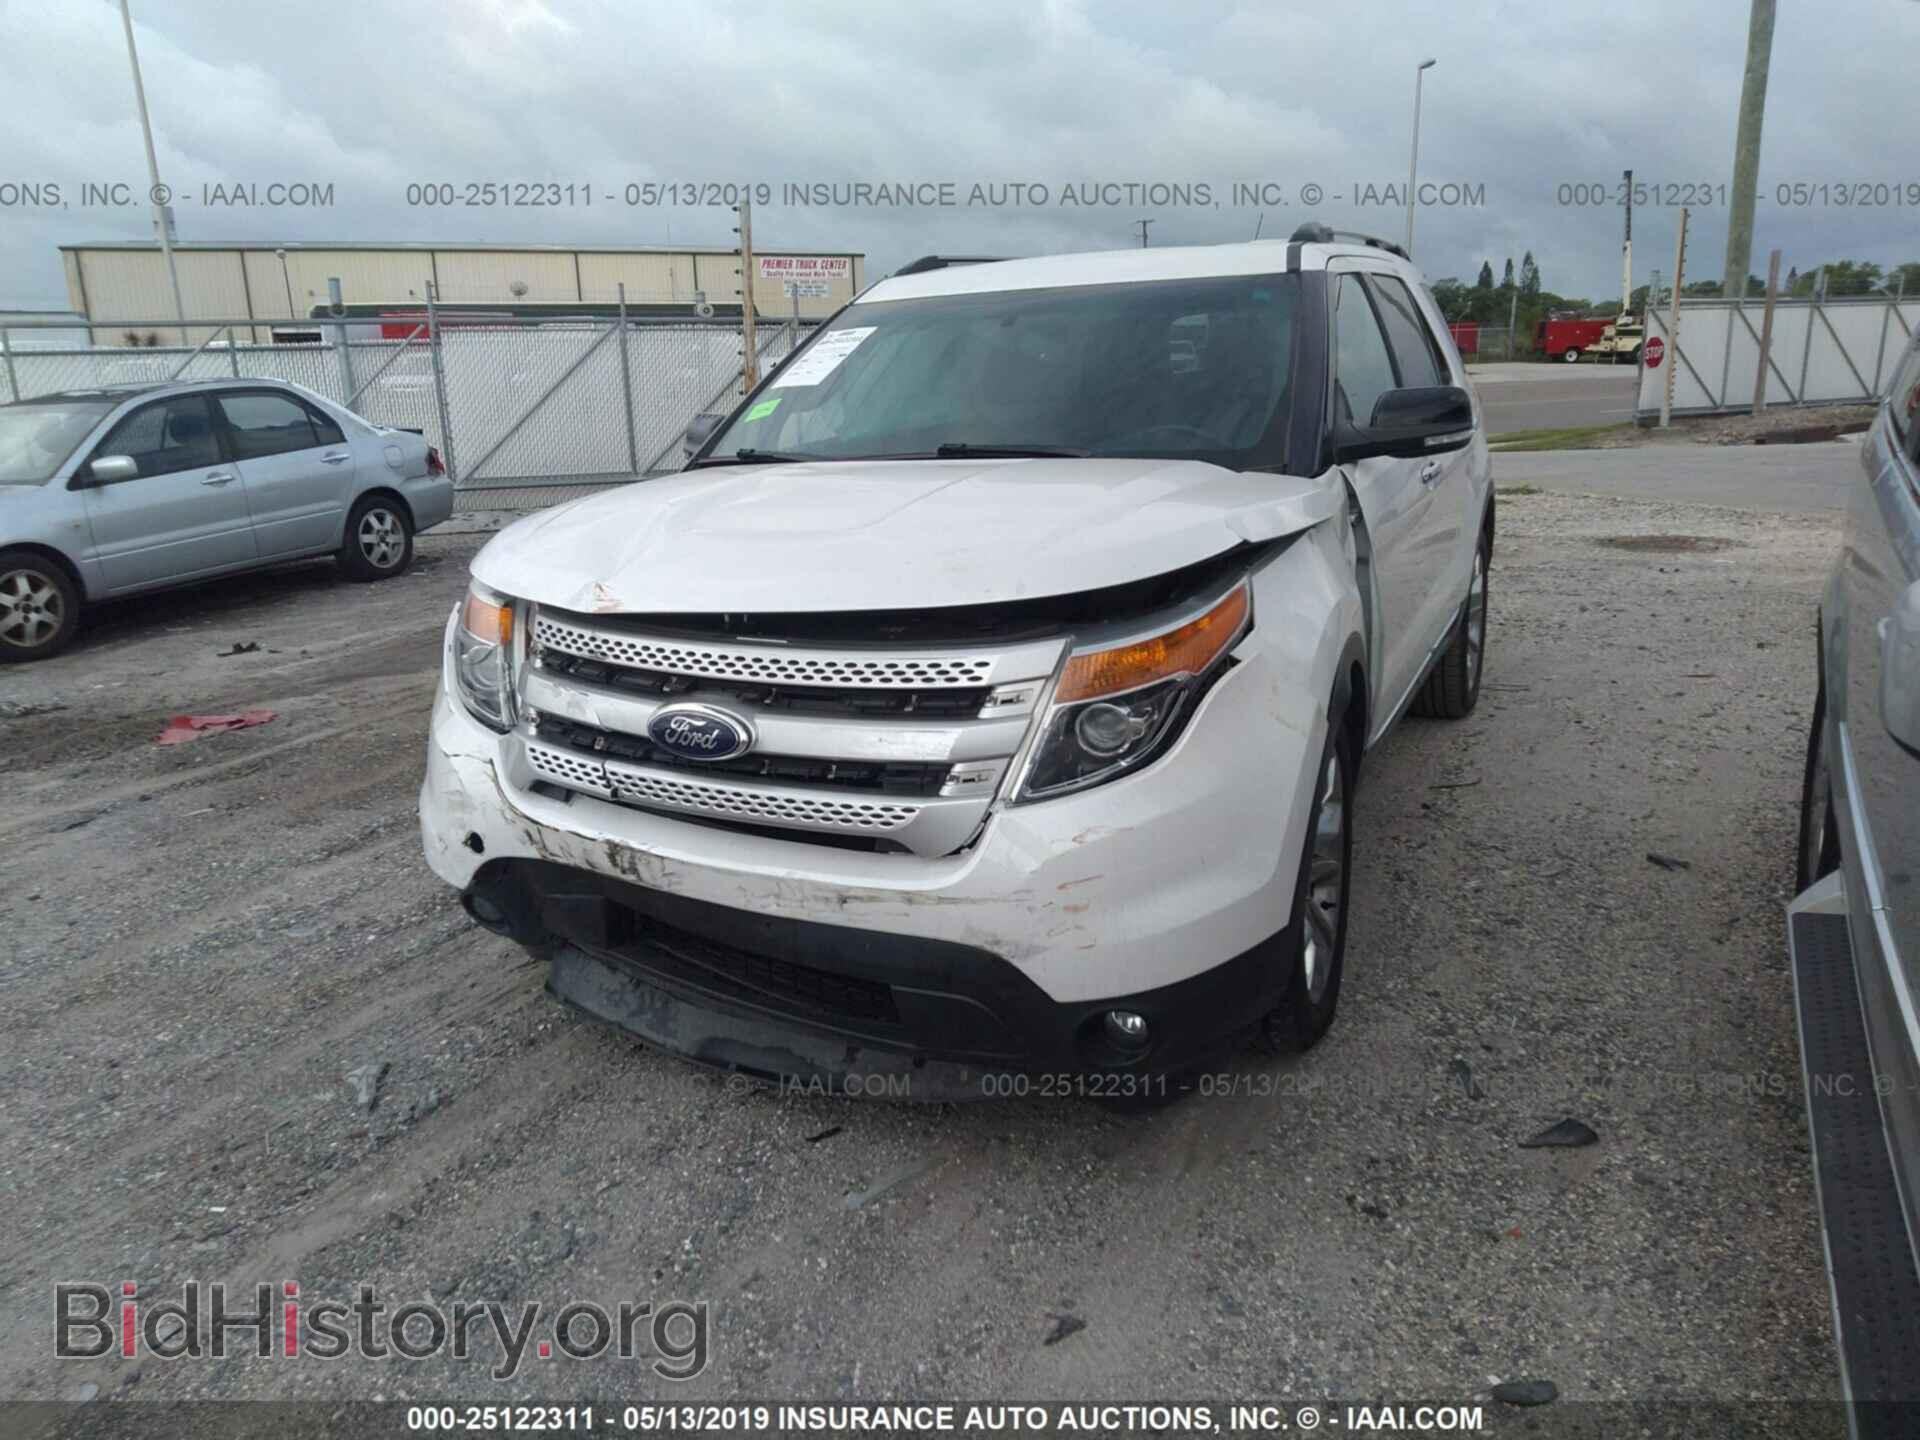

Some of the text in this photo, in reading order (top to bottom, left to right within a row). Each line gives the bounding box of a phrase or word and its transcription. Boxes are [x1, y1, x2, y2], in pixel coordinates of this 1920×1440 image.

[762, 258, 847, 269] PREMIER TRUCK CENTER
[1646, 346, 1664, 358] STOP
[665, 716, 719, 748] Ford
